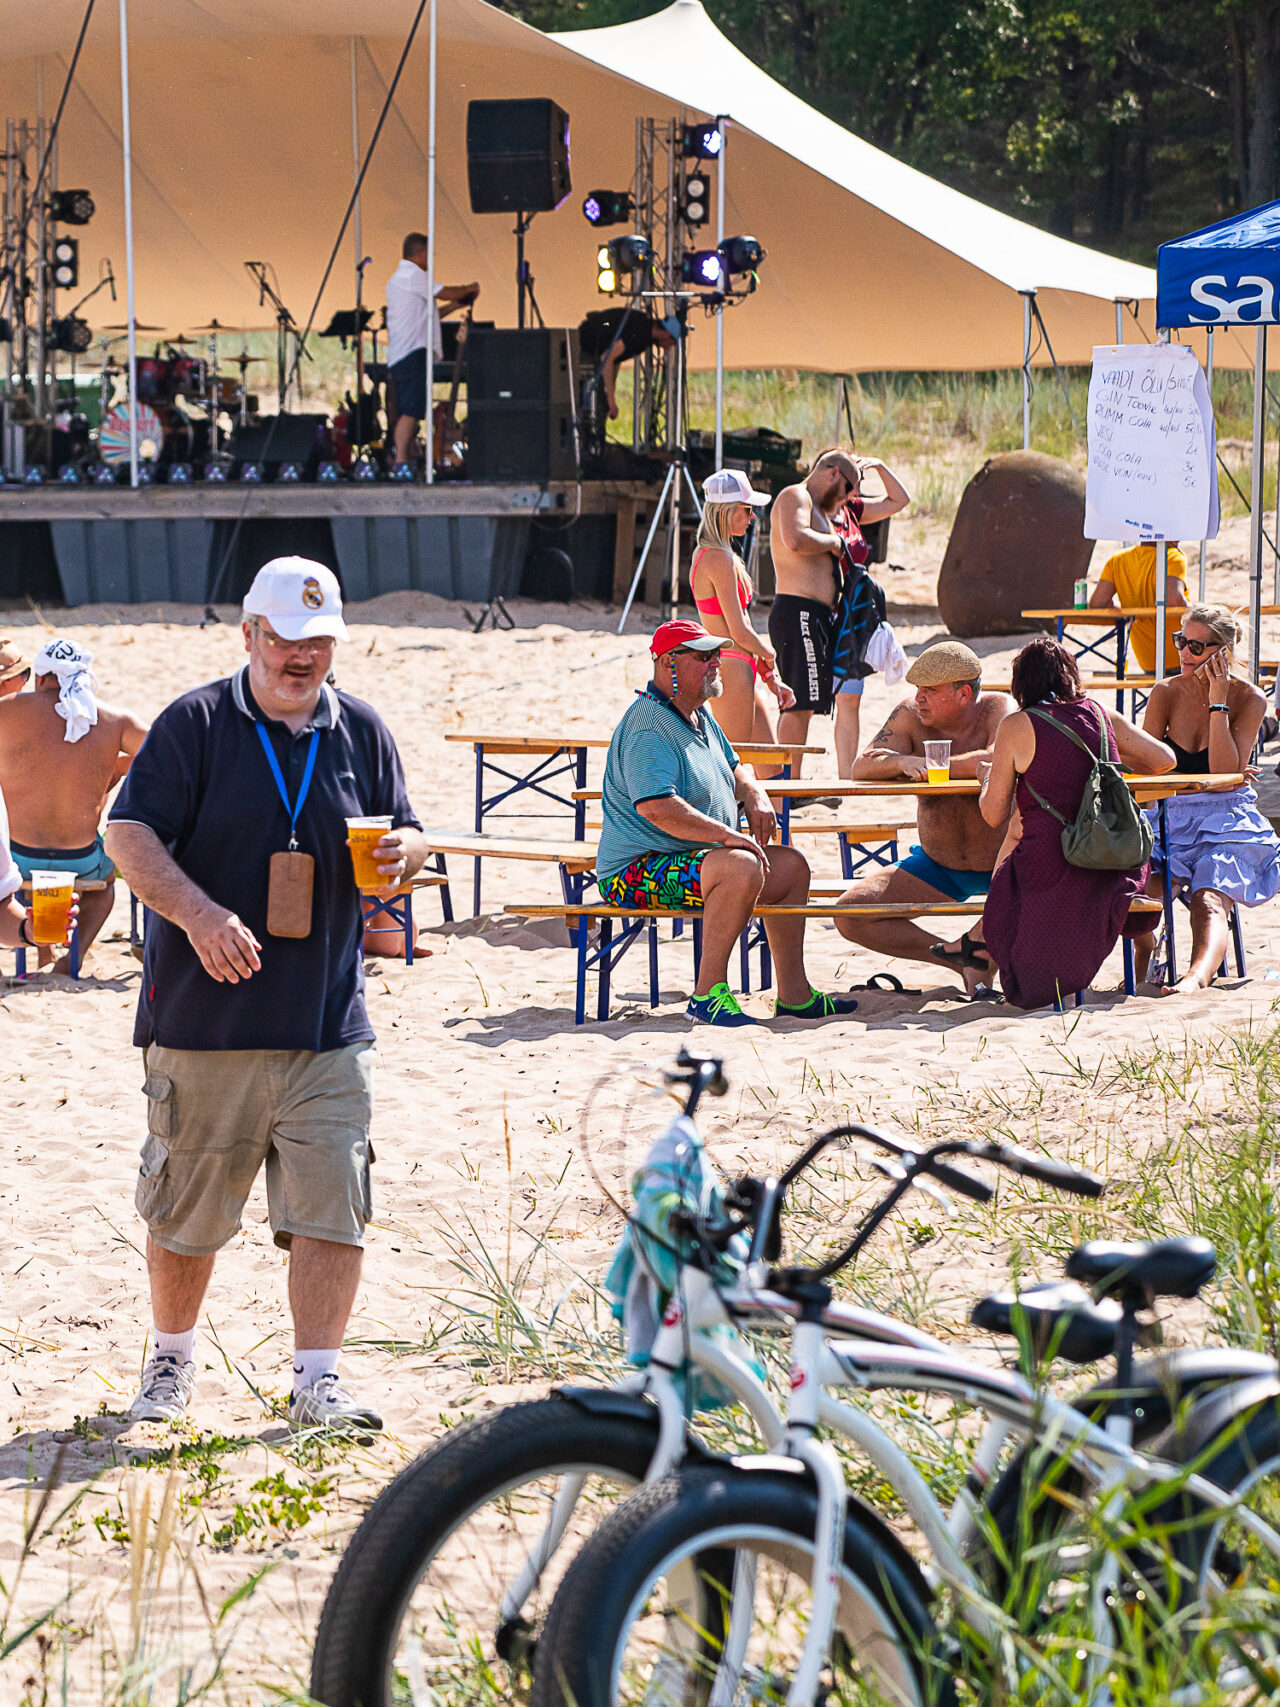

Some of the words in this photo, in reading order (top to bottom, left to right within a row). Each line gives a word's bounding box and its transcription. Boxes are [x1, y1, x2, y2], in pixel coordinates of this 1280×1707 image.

[1102, 369, 1134, 391] VAADI
[1096, 389, 1123, 405] GIN
[800, 610, 810, 637] BLACK
